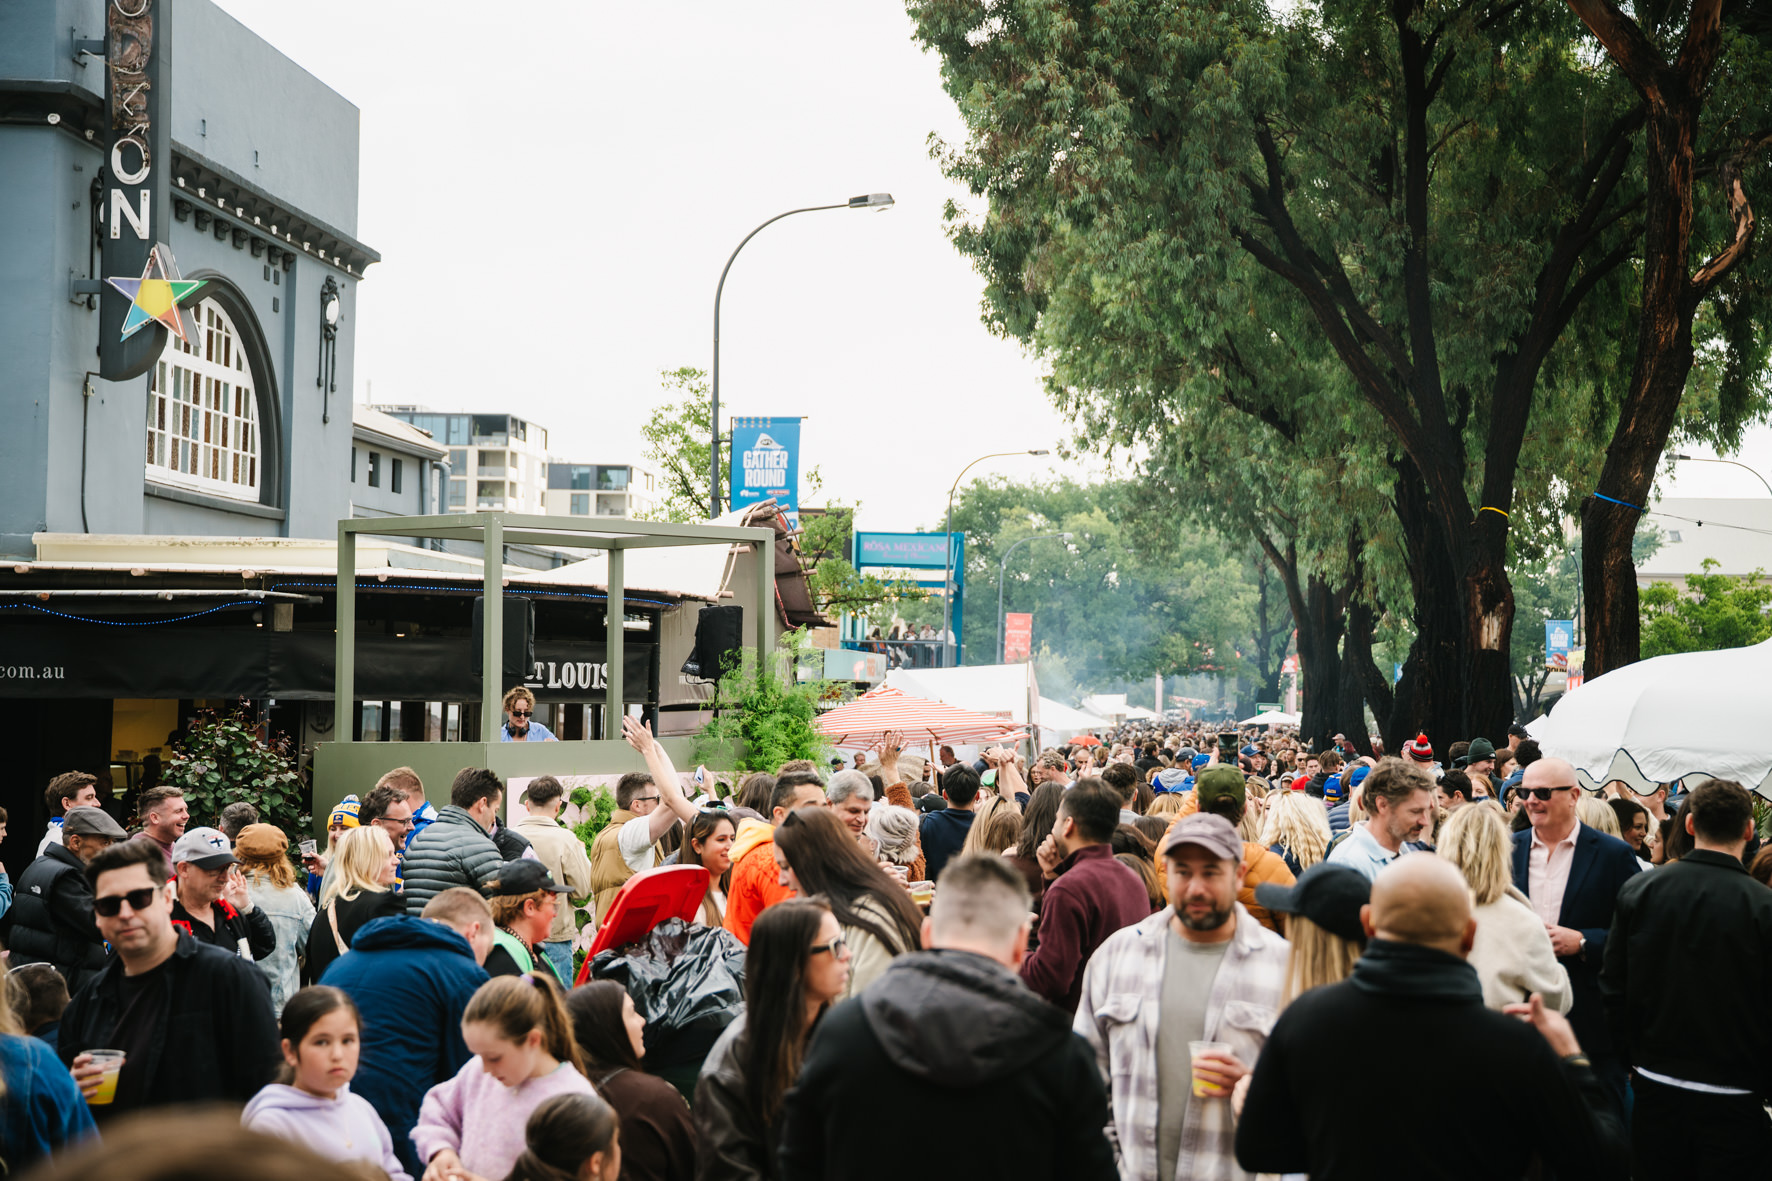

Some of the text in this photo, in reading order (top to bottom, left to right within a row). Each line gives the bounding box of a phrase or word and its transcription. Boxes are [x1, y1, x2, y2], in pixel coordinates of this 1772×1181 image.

[743, 450, 788, 469] GATHER
[744, 469, 786, 488] ROUND
[0, 666, 65, 679] com.au
[524, 662, 545, 680] T
